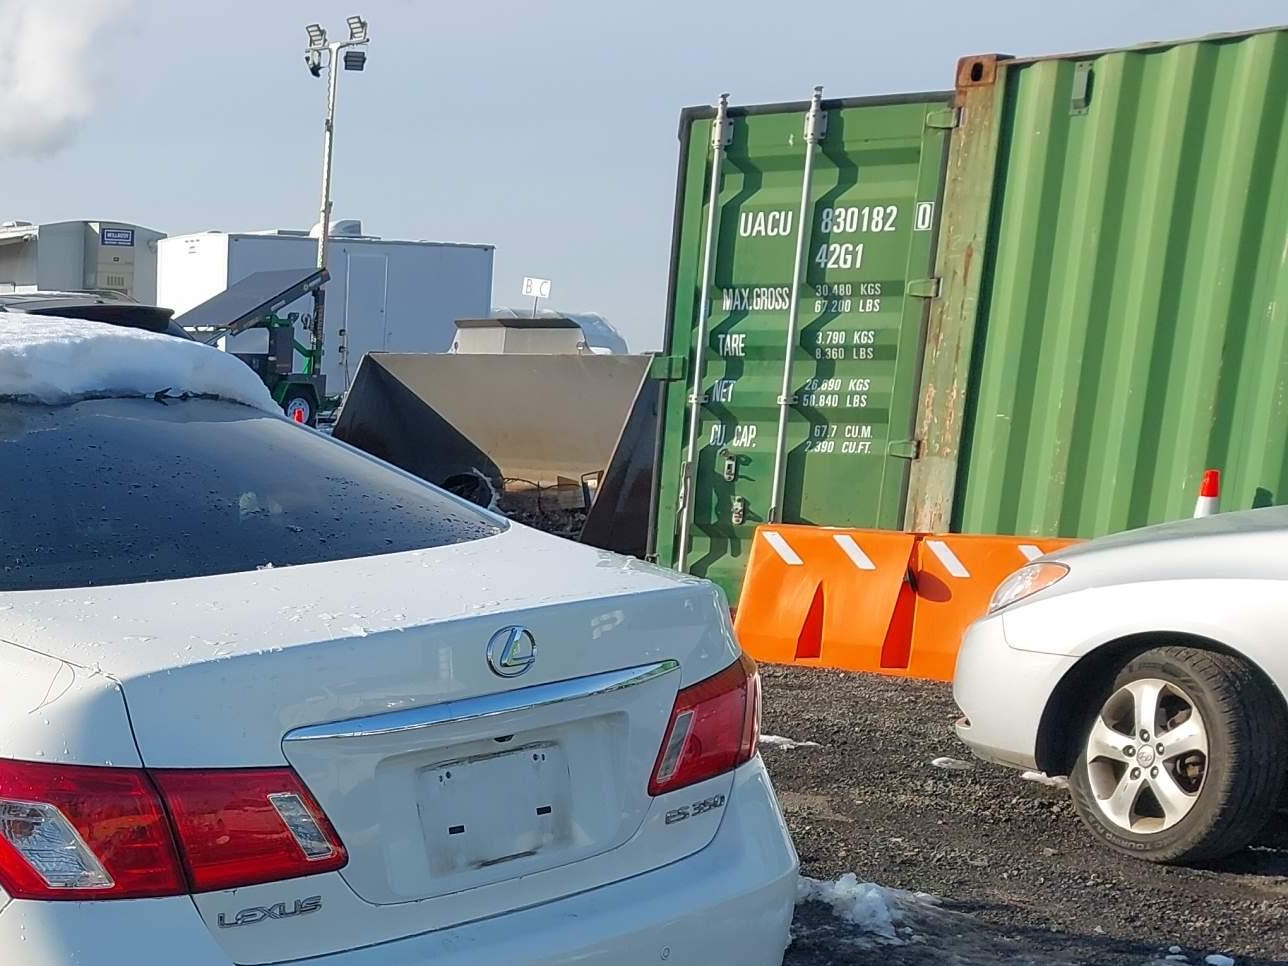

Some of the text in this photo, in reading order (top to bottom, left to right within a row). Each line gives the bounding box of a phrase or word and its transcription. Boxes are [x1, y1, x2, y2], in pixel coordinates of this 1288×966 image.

[739, 203, 932, 237] UACU 830182 0
[814, 243, 864, 270] 42G1
[722, 287, 790, 311] MAX.GROSS
[860, 283, 881, 296] KGS
[814, 299, 880, 313] 67.200 LBS
[718, 333, 747, 357] TARE
[816, 331, 875, 345] 3.790 KGS
[815, 347, 874, 360] 8.360 LBS
[712, 379, 737, 403] NET
[848, 378, 871, 391] KGS
[846, 394, 868, 408] LBS
[709, 424, 757, 448] CU. CAP.
[814, 425, 873, 438] 67.7 CU.M.
[804, 440, 834, 453] 2.390
[664, 794, 727, 826] ES 350
[216, 895, 323, 929] LEXUS
